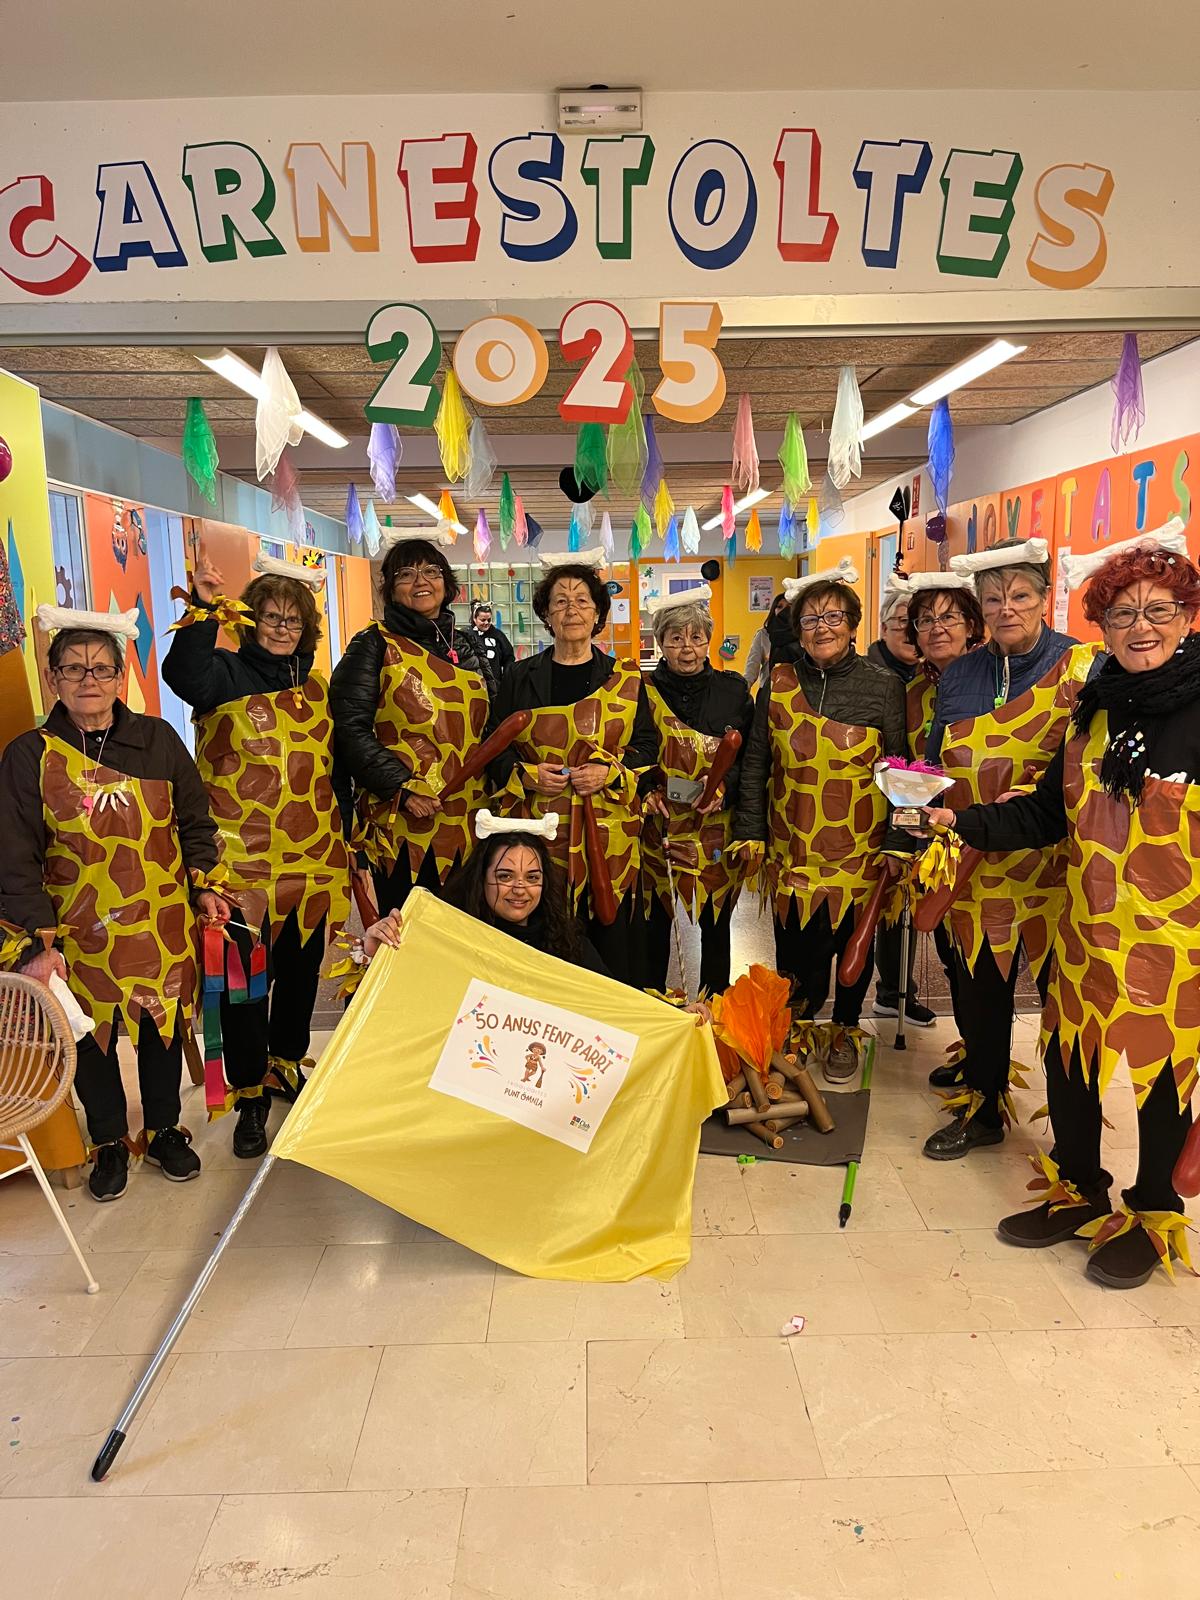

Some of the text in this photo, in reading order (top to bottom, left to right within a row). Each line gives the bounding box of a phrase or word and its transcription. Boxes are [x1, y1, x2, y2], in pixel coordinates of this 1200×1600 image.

[0, 128, 1115, 296] CARNESTOLTES
[364, 300, 727, 427] 2025
[475, 1012, 614, 1074] 50 ANYS FENT BARRI
[504, 1087, 520, 1099] PUNT
